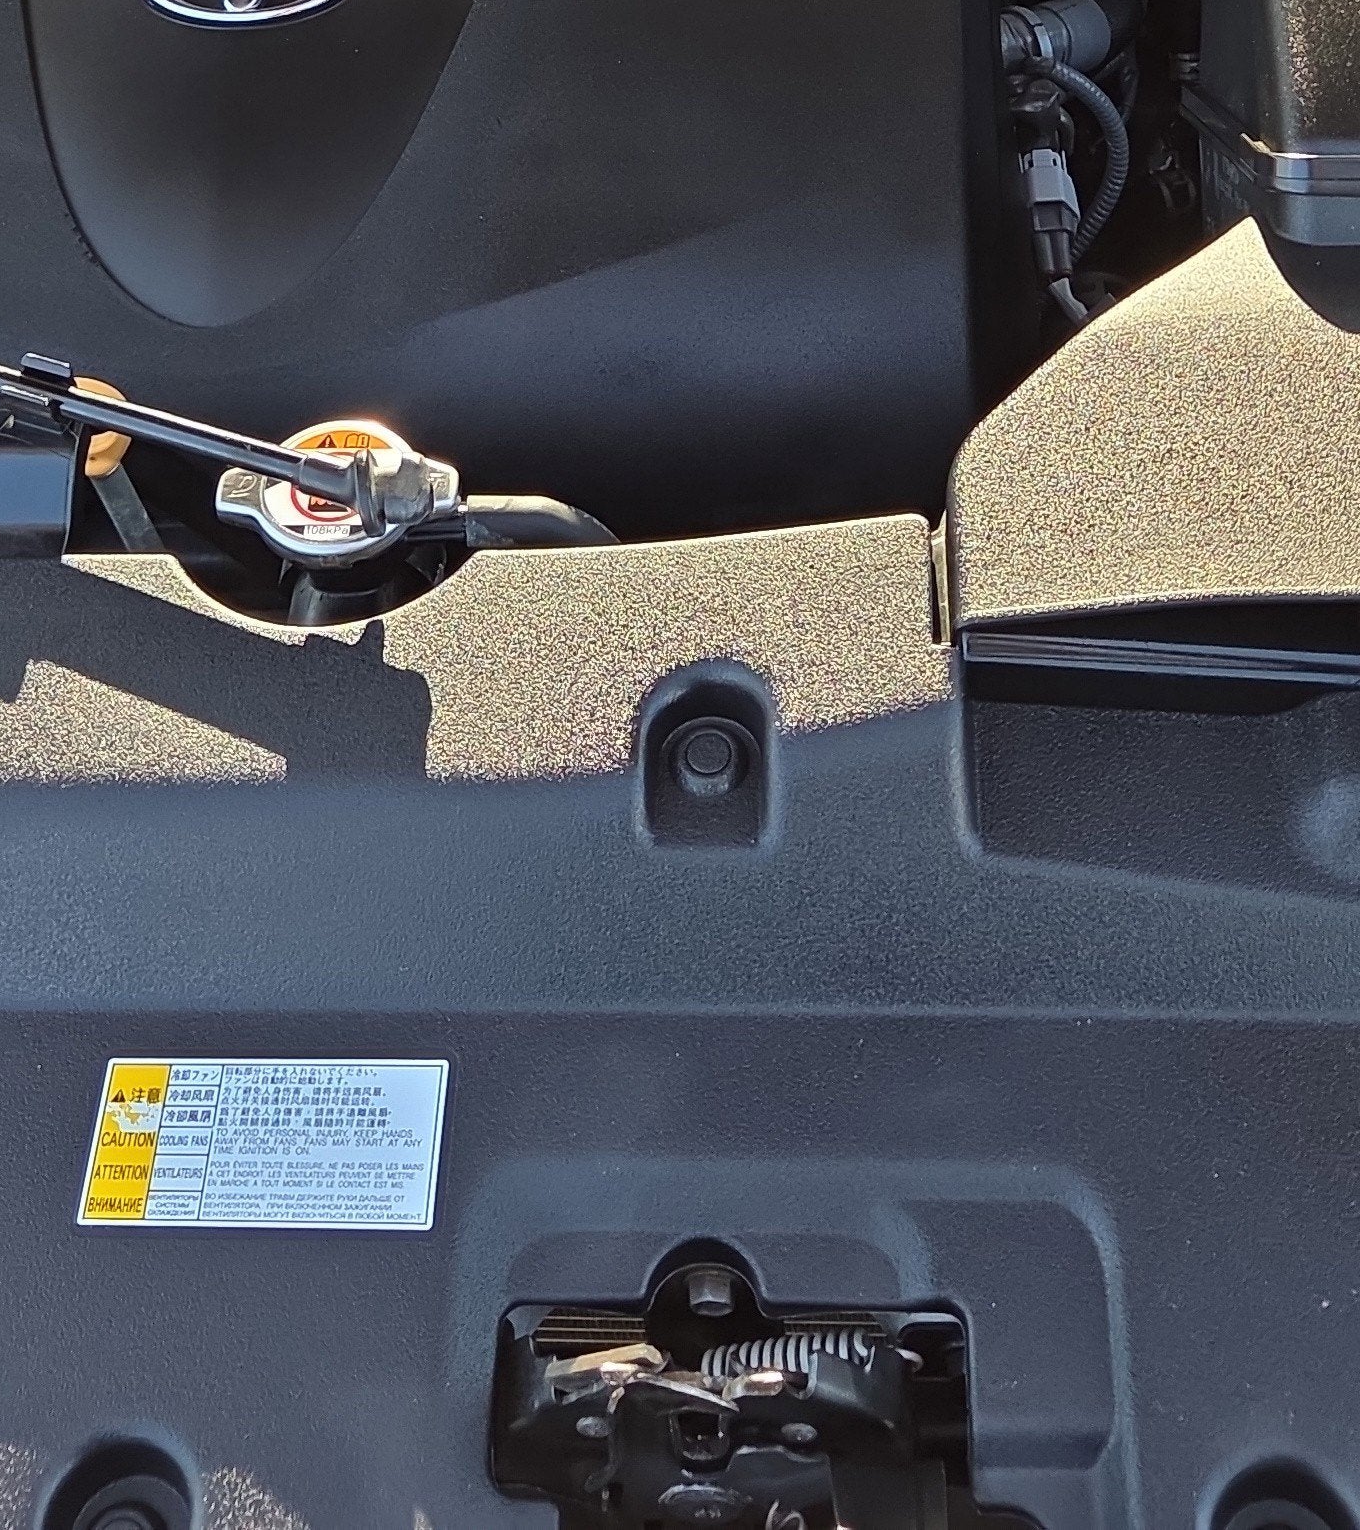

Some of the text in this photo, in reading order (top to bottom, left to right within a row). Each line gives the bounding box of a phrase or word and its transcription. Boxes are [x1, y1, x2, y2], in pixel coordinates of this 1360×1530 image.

[171, 1069, 220, 1082] 冷却ファン
[129, 1086, 162, 1104] 注意
[101, 1131, 157, 1148] CAUTION
[216, 1128, 229, 1137] TO
[232, 1128, 260, 1137] AVOID
[263, 1128, 310, 1138] PERSONAL
[353, 1129, 378, 1139] KEEP
[381, 1129, 414, 1139] HANDS
[190, 1135, 209, 1147] FANS
[214, 1137, 240, 1146] AWAY
[242, 1137, 270, 1146] FROM
[302, 1138, 328, 1147] FANS
[331, 1138, 352, 1147] MAY
[354, 1138, 383, 1147] START
[387, 1139, 399, 1147] AT
[403, 1139, 424, 1148] ANY
[213, 1146, 234, 1155] TIME
[237, 1146, 278, 1156] IGNITION
[281, 1146, 291, 1156] IS
[93, 1164, 150, 1181] ATTENTION
[87, 1196, 144, 1213] ВНИМАНИЕ
